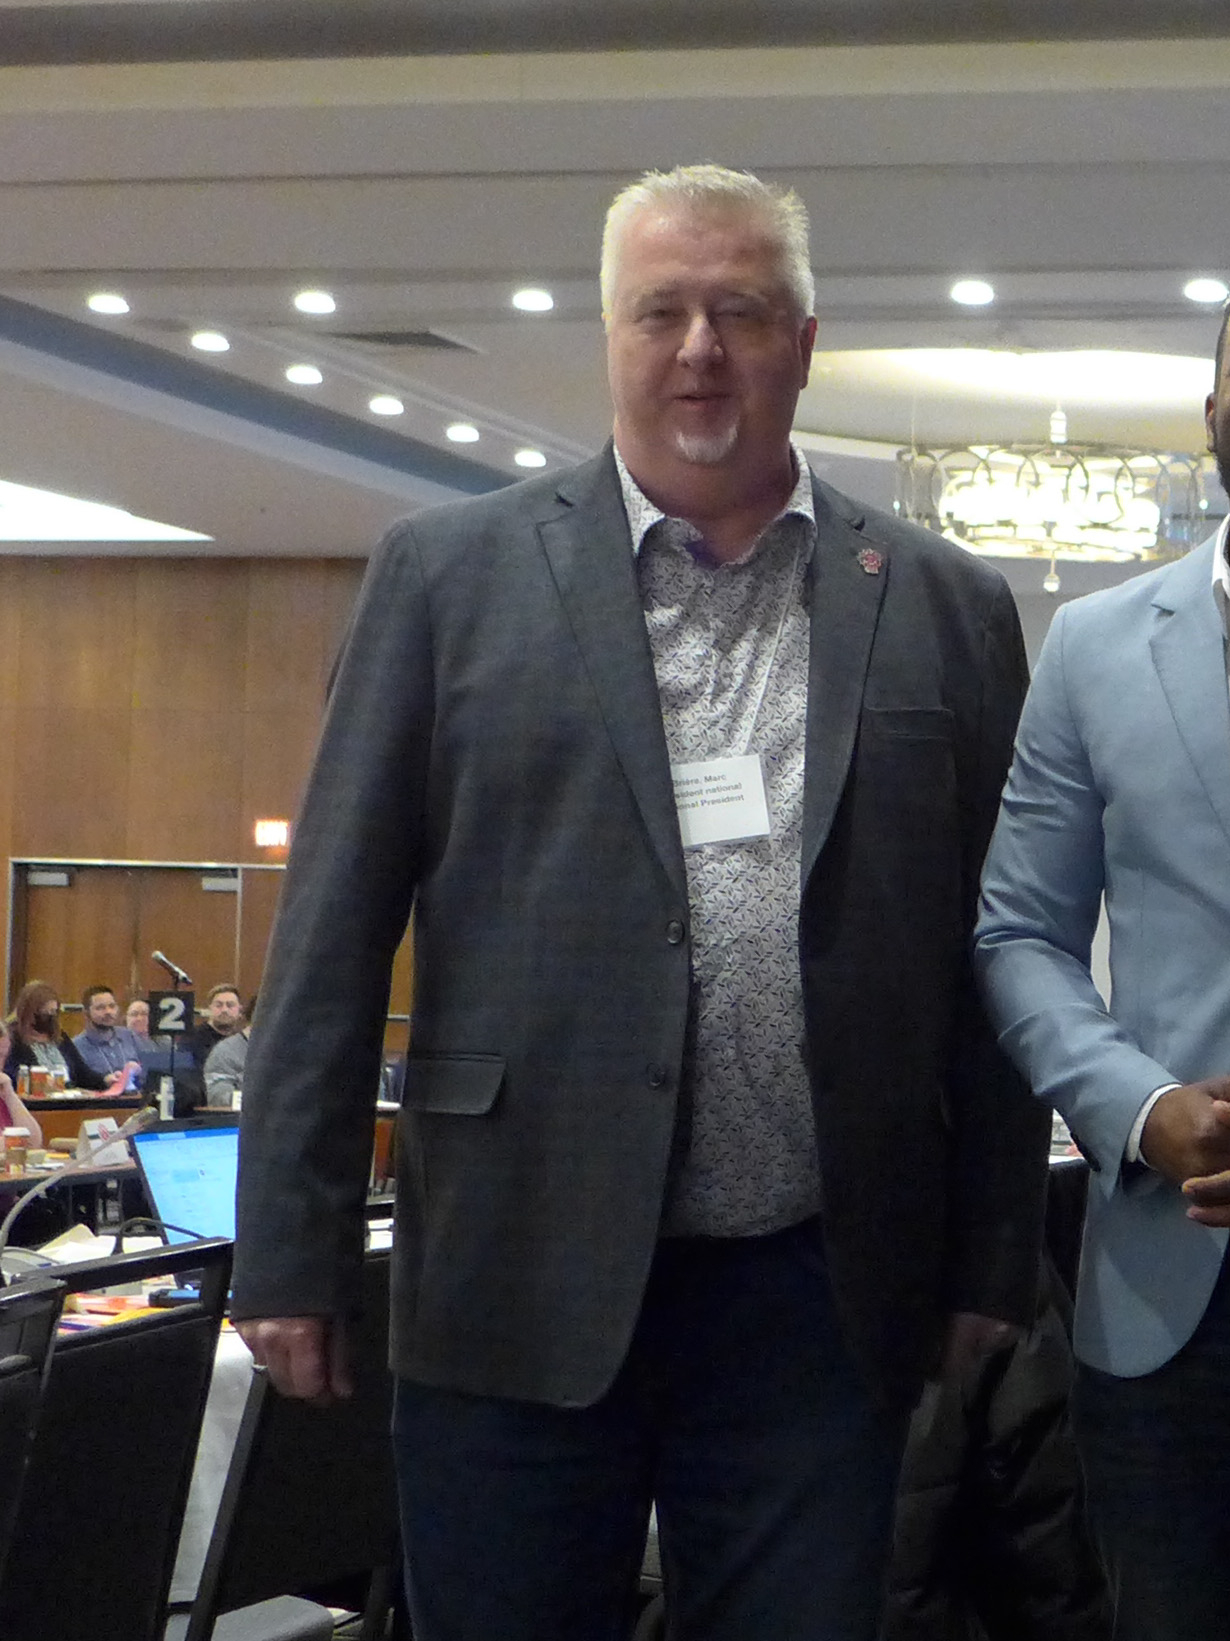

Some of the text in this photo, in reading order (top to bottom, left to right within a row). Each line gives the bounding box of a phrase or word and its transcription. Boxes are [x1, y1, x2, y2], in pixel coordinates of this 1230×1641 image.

[704, 775, 726, 783] Marc
[675, 783, 742, 798] sident national
[678, 795, 745, 810] onal President
[158, 997, 186, 1030] 2
